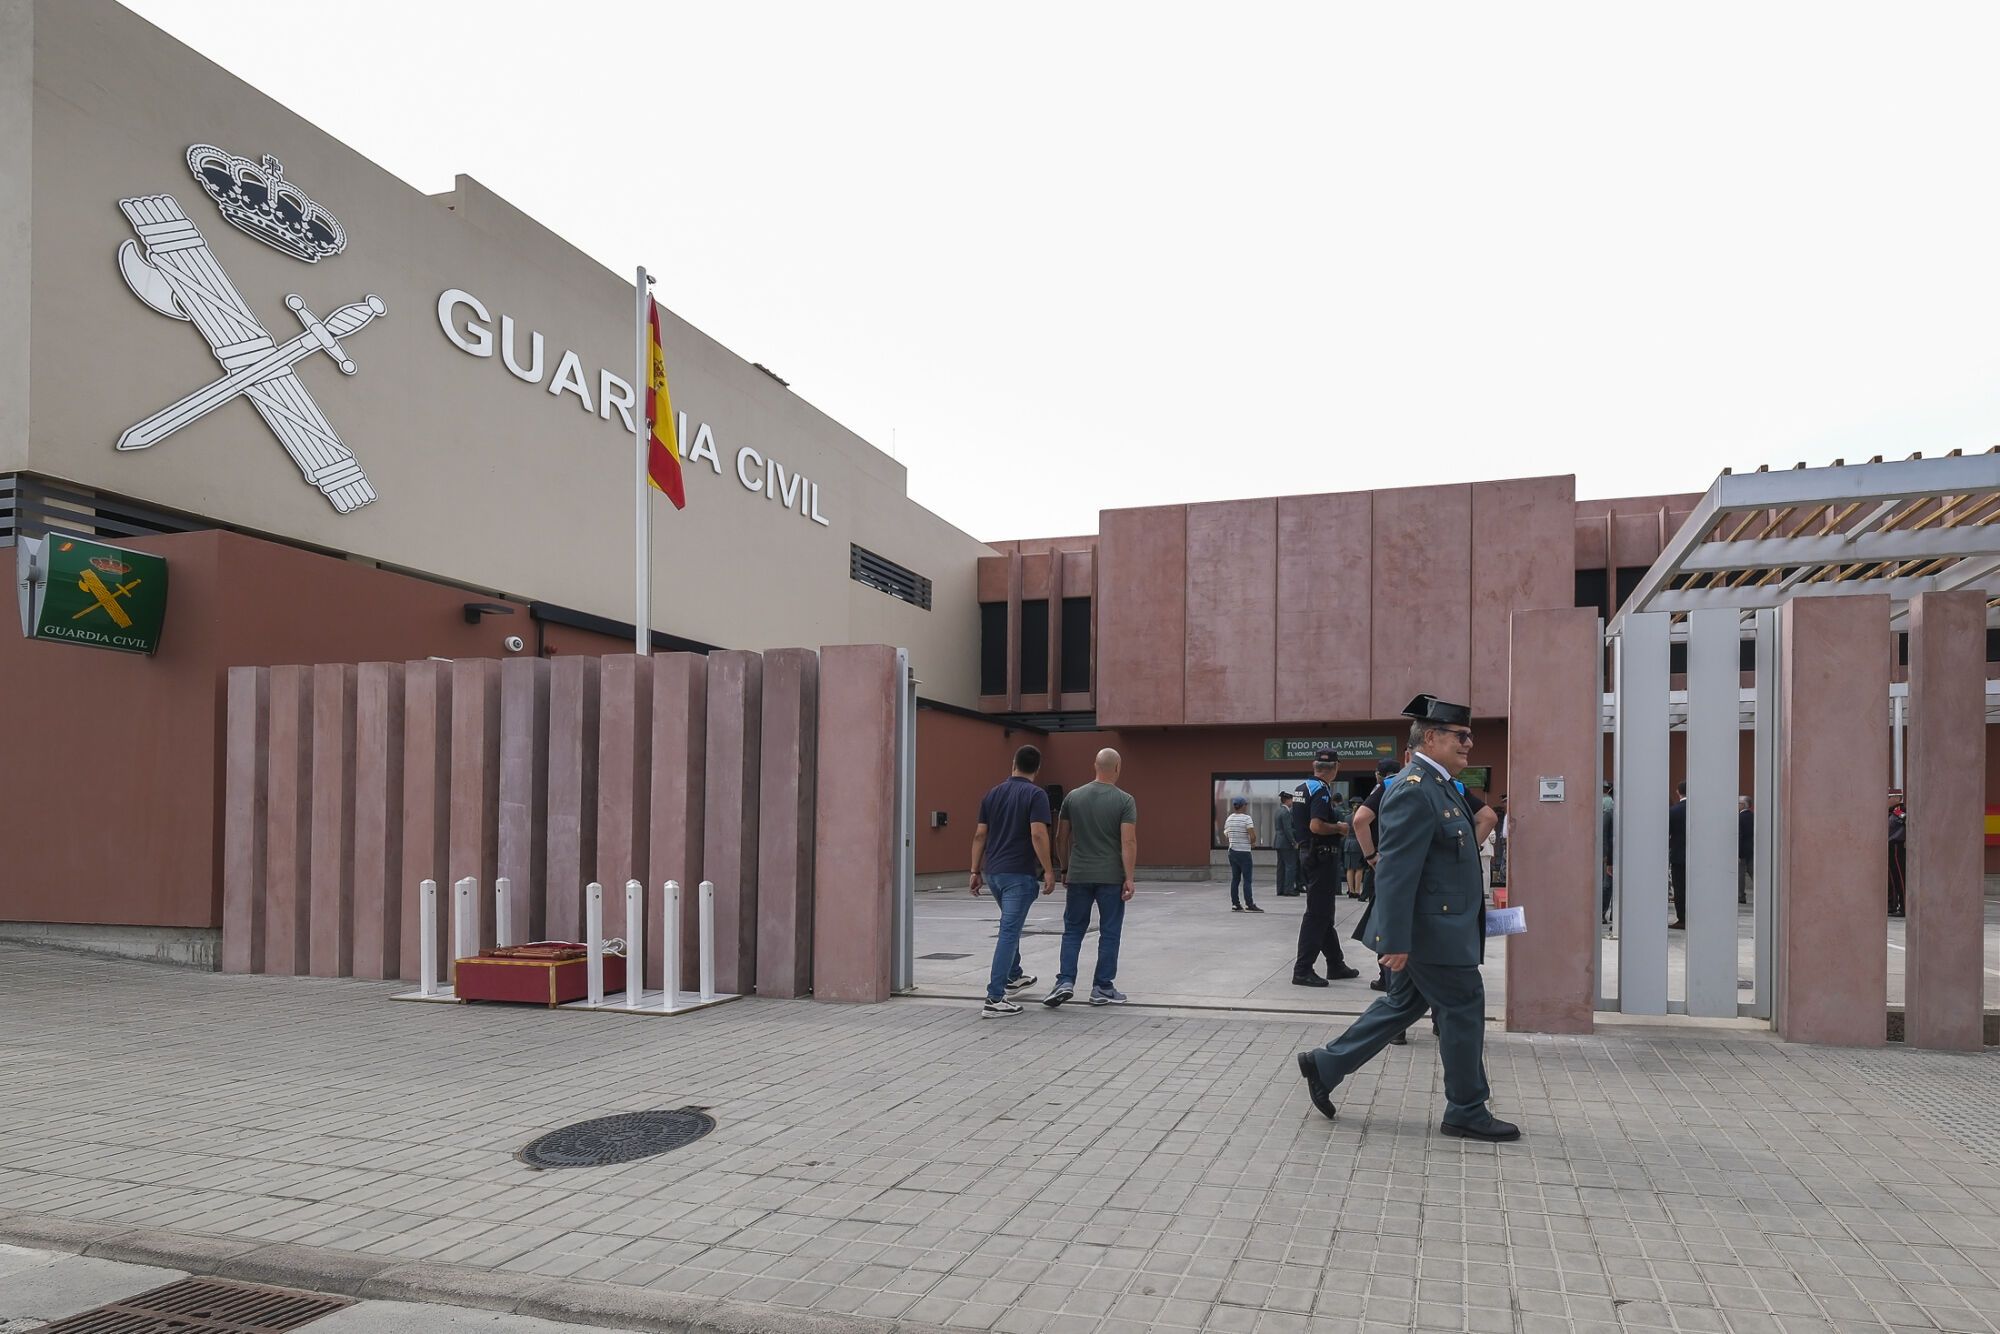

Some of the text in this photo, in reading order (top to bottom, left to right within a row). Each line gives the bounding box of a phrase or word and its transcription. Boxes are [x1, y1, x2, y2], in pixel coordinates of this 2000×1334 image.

[437, 288, 830, 527] GUARIA CIVIL
[44, 625, 148, 649] GUARDIA CIVIL
[1311, 741, 1329, 749] POR
[1331, 741, 1342, 749] LA
